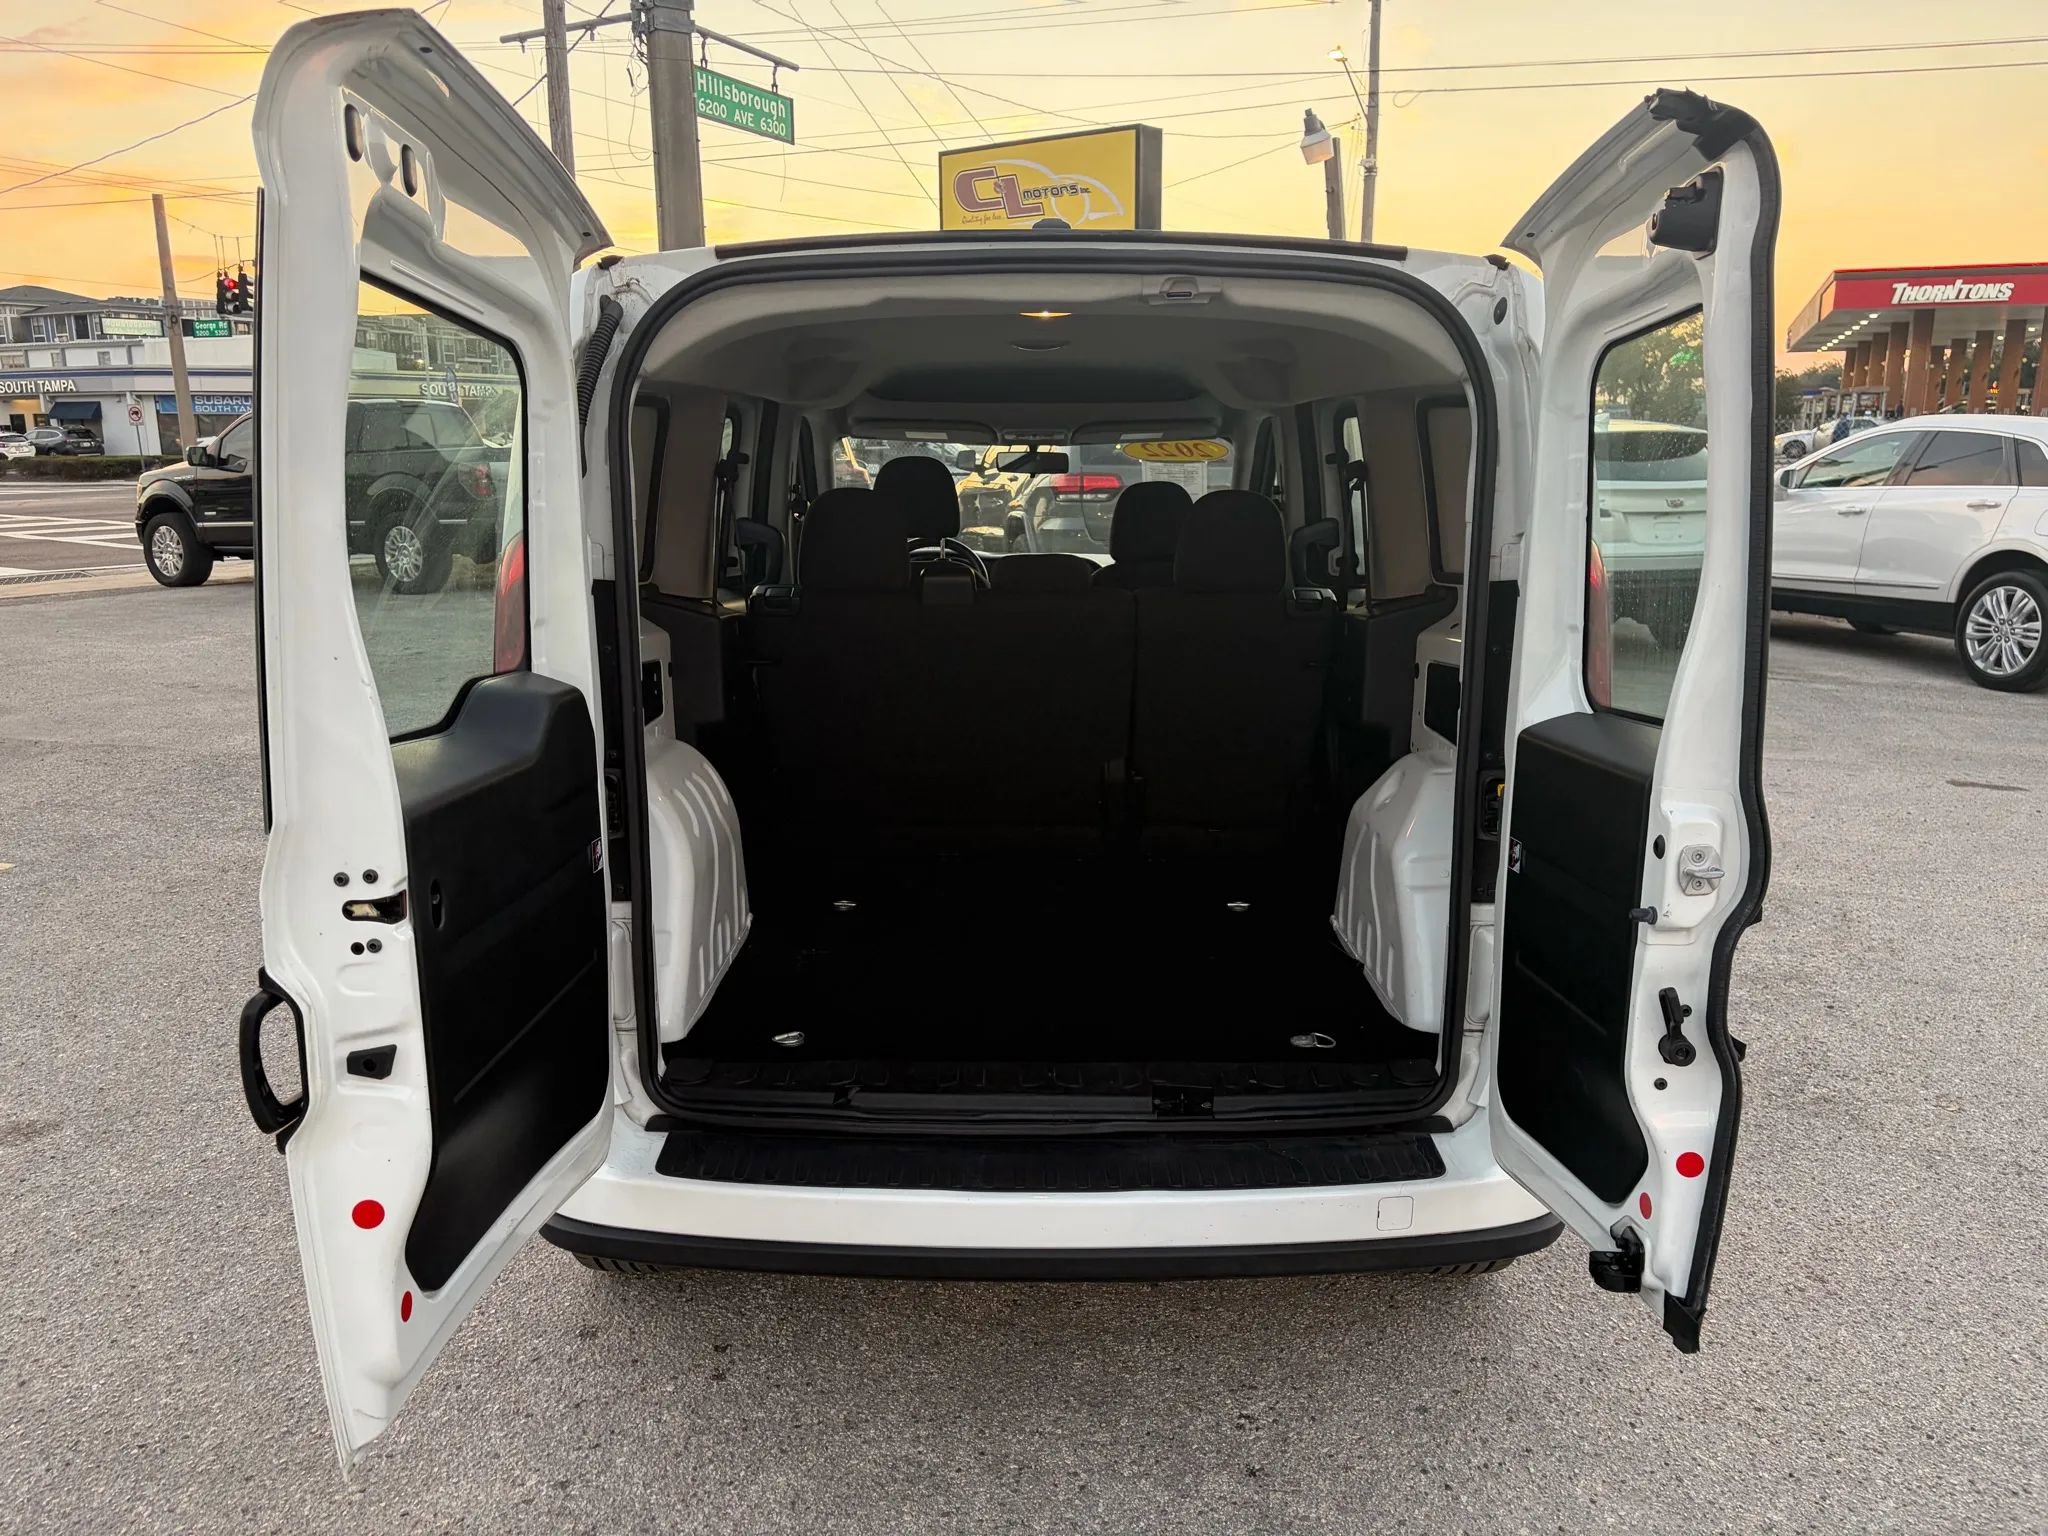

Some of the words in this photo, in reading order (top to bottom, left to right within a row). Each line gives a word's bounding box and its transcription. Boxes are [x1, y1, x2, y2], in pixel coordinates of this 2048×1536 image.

[697, 72, 786, 120] Hillsborough
[699, 98, 728, 118] 6200
[733, 110, 755, 127] AVE
[760, 118, 786, 136] 6300
[195, 321, 217, 331] George
[218, 320, 229, 329] Rd
[0, 380, 36, 393] SOUTH
[37, 379, 76, 392] TAMPA
[421, 383, 463, 397] SOU
[194, 395, 252, 406] SUBARU
[194, 405, 231, 413] SOUTH
